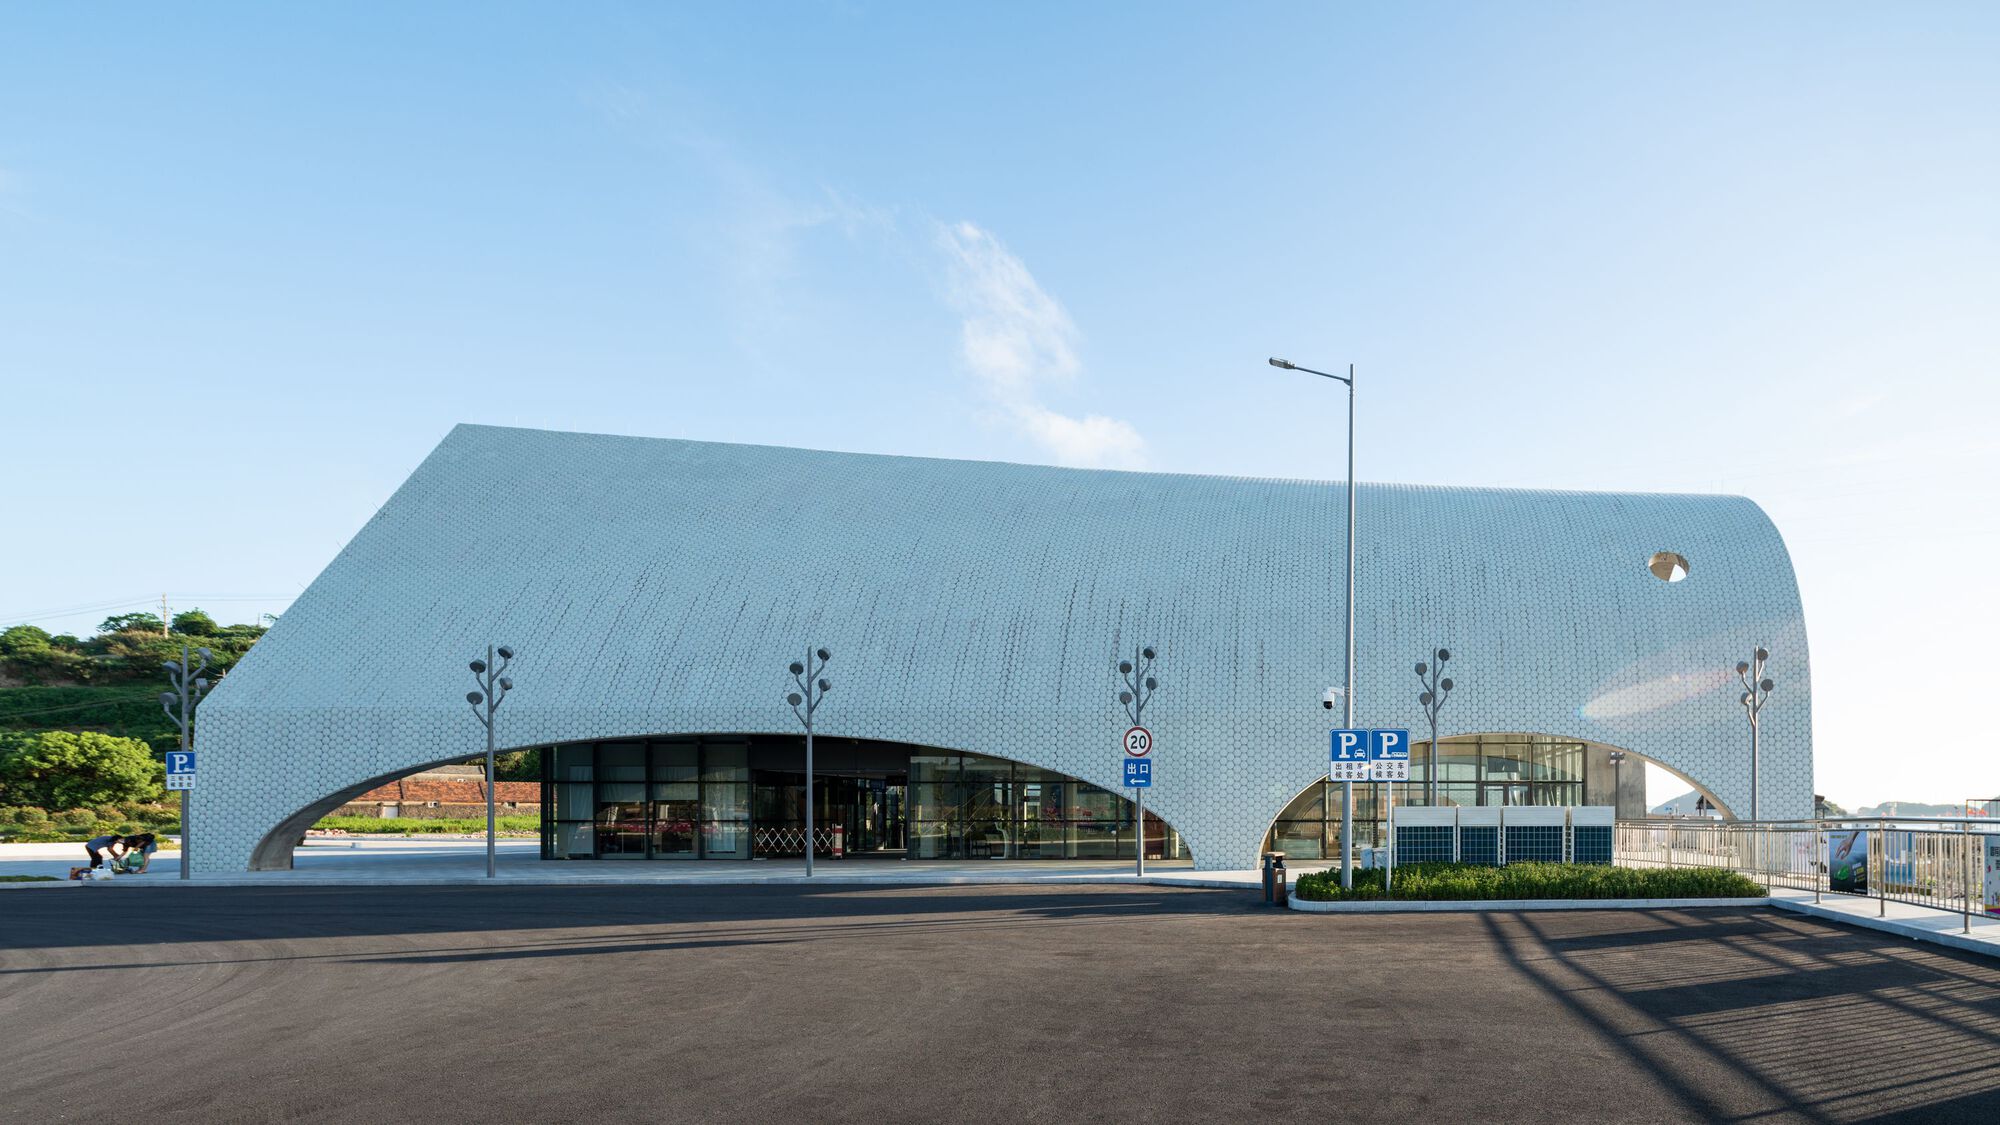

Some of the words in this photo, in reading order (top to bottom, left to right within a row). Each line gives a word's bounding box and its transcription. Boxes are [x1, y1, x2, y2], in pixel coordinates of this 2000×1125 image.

[1130, 734, 1147, 750] 20
[1338, 732, 1357, 758] P
[1379, 732, 1398, 758] P
[173, 754, 188, 773] P
[1127, 762, 1149, 775] 出口
[1375, 762, 1404, 770] 公交车
[1375, 770, 1404, 779] 候客处
